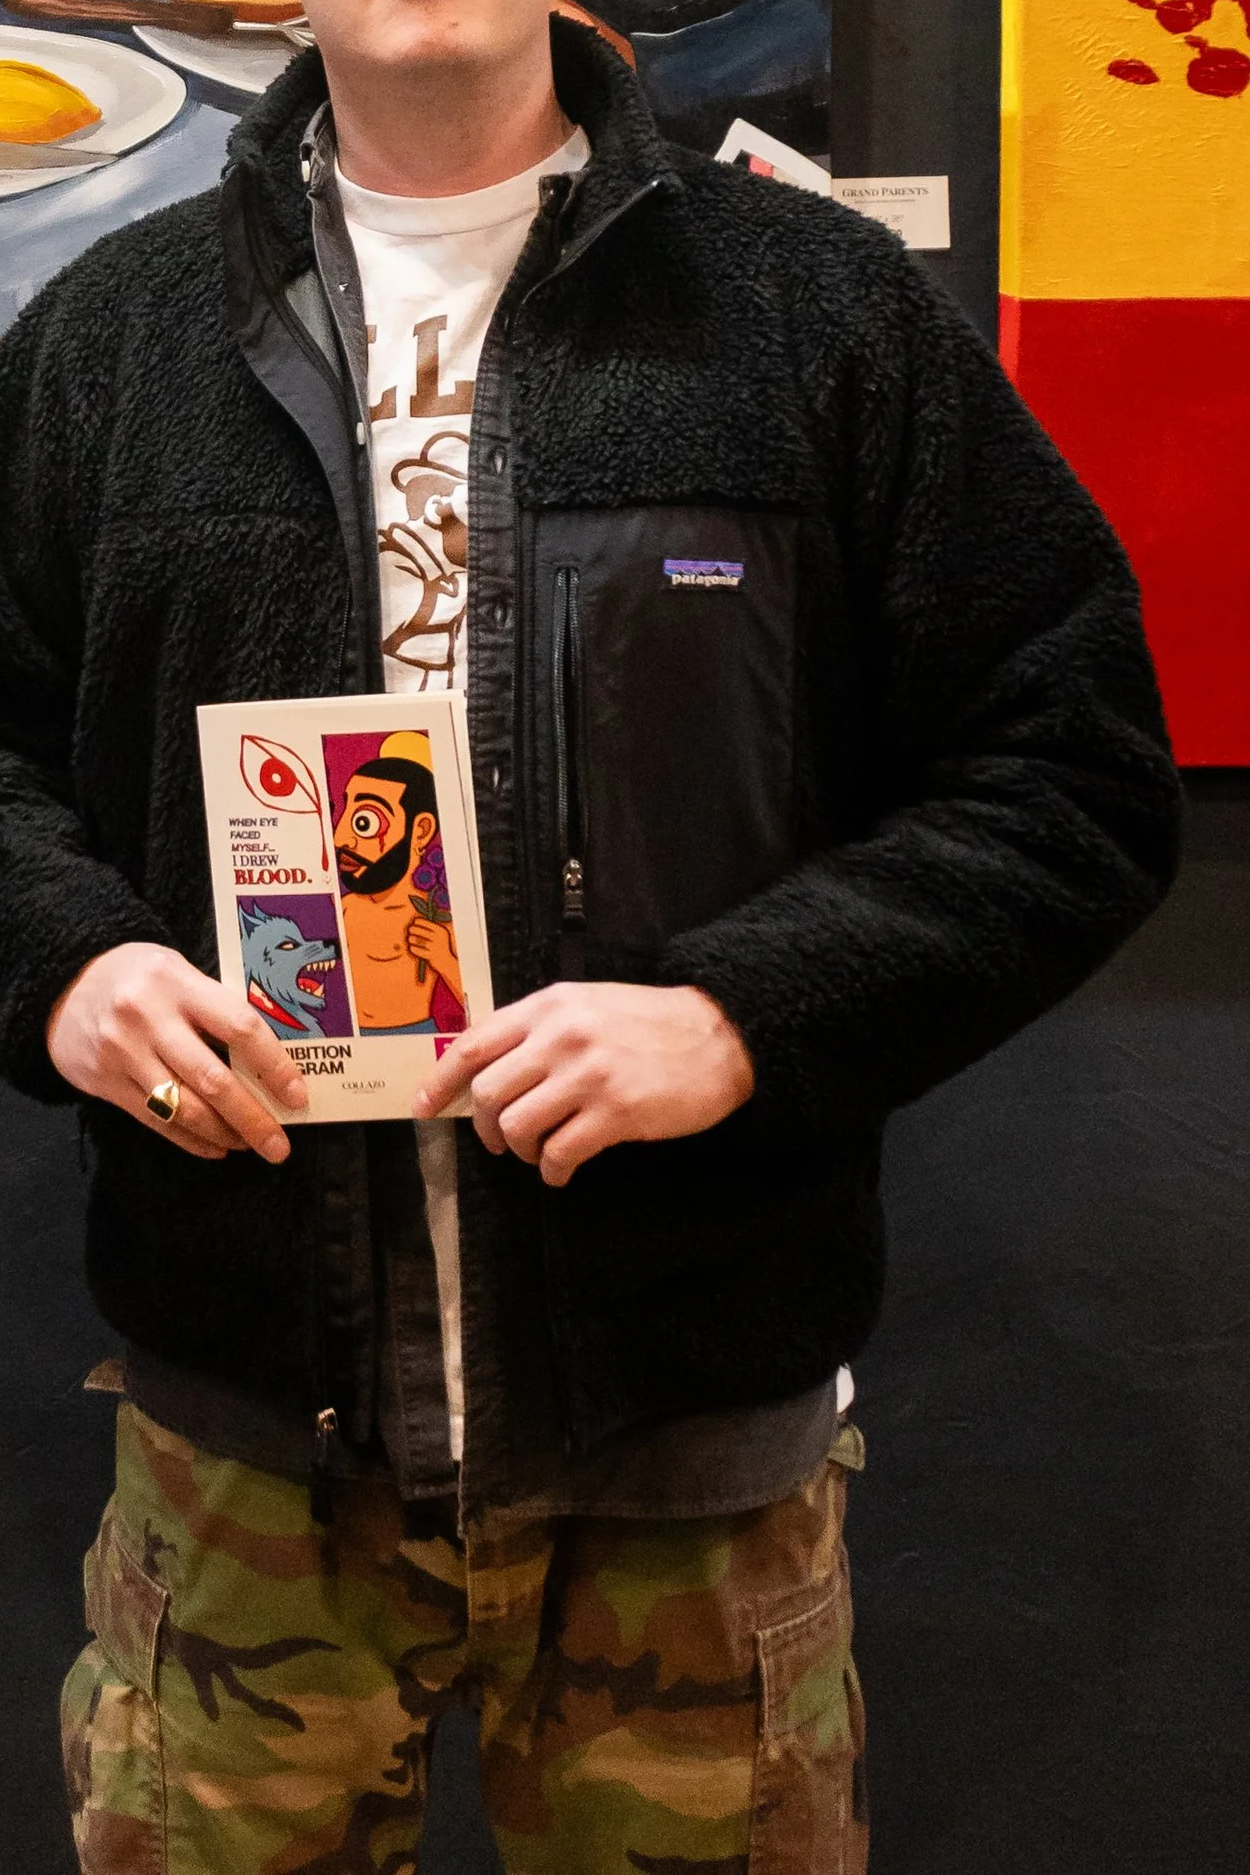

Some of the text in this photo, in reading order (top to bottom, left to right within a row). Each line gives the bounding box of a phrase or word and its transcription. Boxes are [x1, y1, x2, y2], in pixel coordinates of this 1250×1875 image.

[842, 187, 929, 197] GRAND PARENTS
[229, 817, 278, 827] WHEN EYE
[230, 831, 261, 839] FACED
[233, 854, 279, 866] I DREW
[234, 868, 313, 885] BLOOD.
[285, 1045, 352, 1060] IBITION
